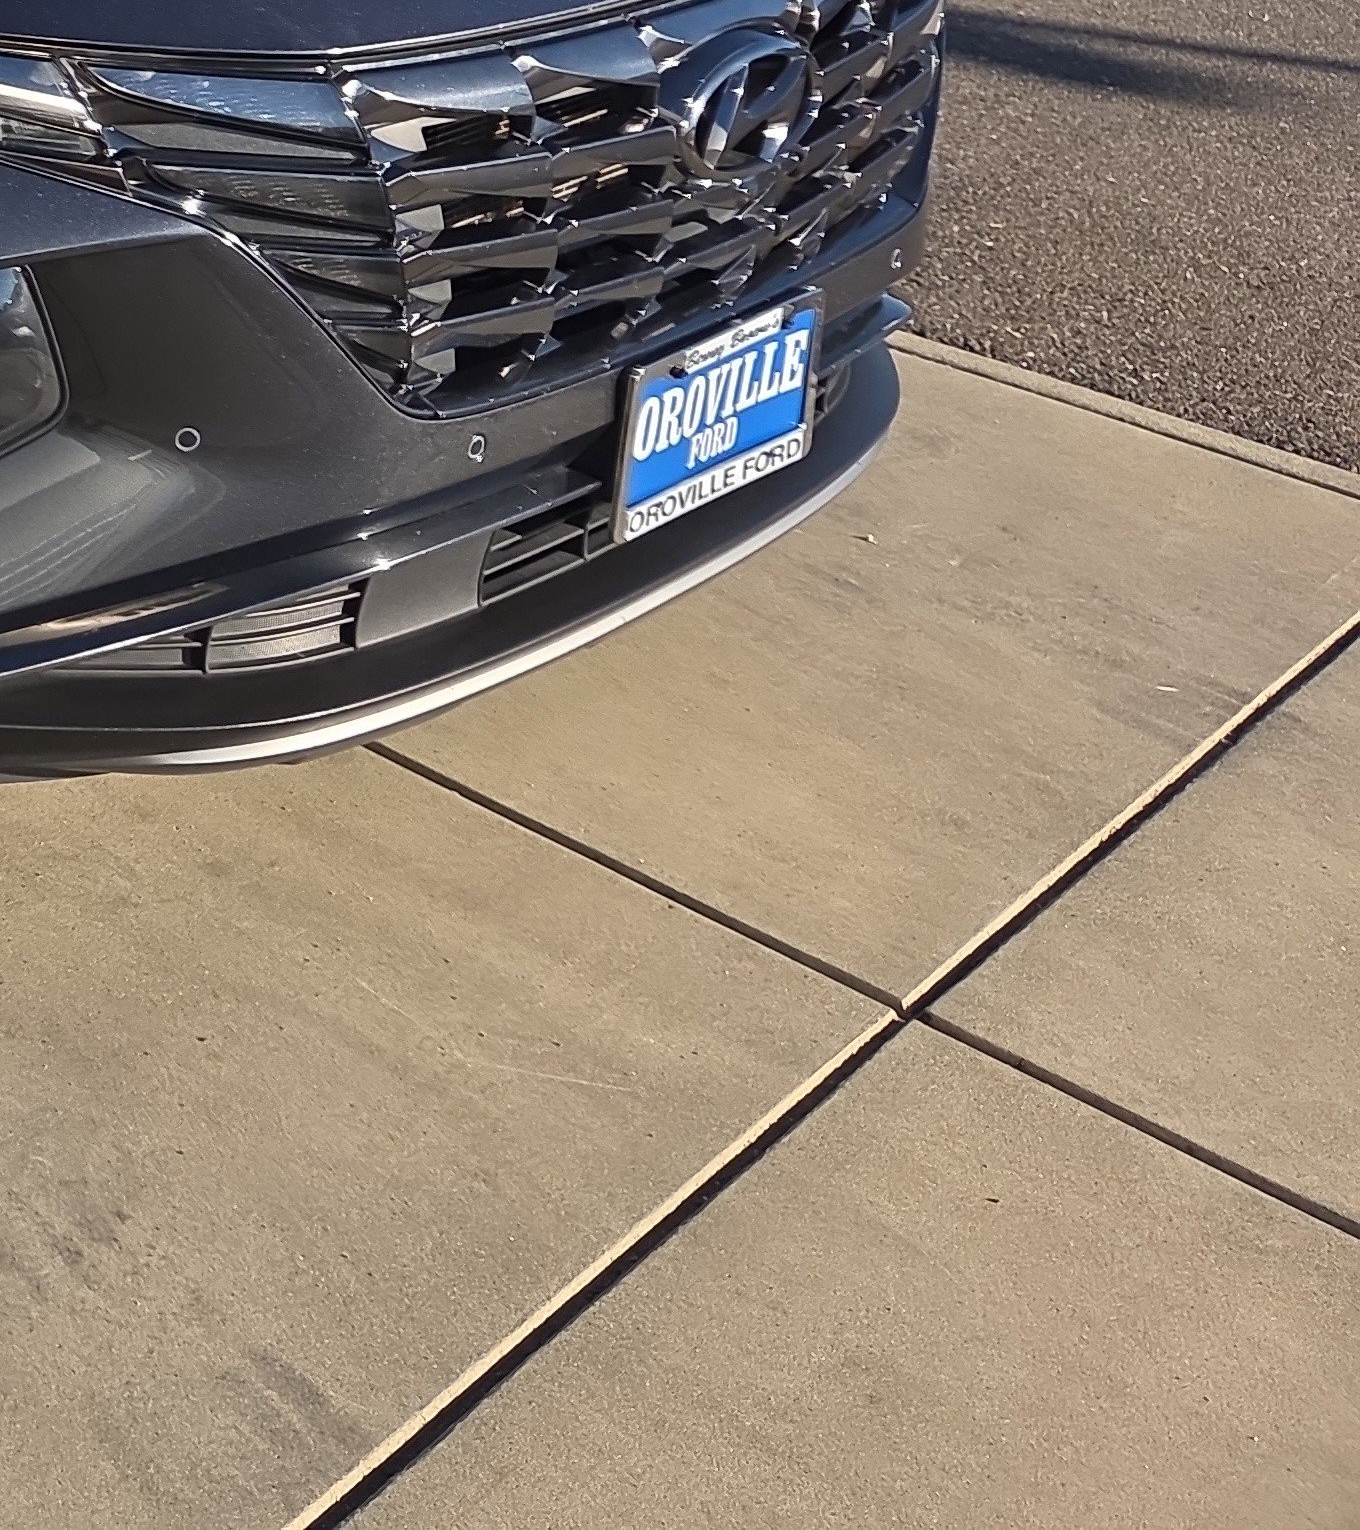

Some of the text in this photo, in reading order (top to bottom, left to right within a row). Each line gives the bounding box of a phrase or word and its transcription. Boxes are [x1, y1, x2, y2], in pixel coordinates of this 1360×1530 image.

[633, 329, 810, 462] OROVILLE
[684, 416, 740, 470] FORD
[628, 436, 803, 533] OROVILLE FORD
